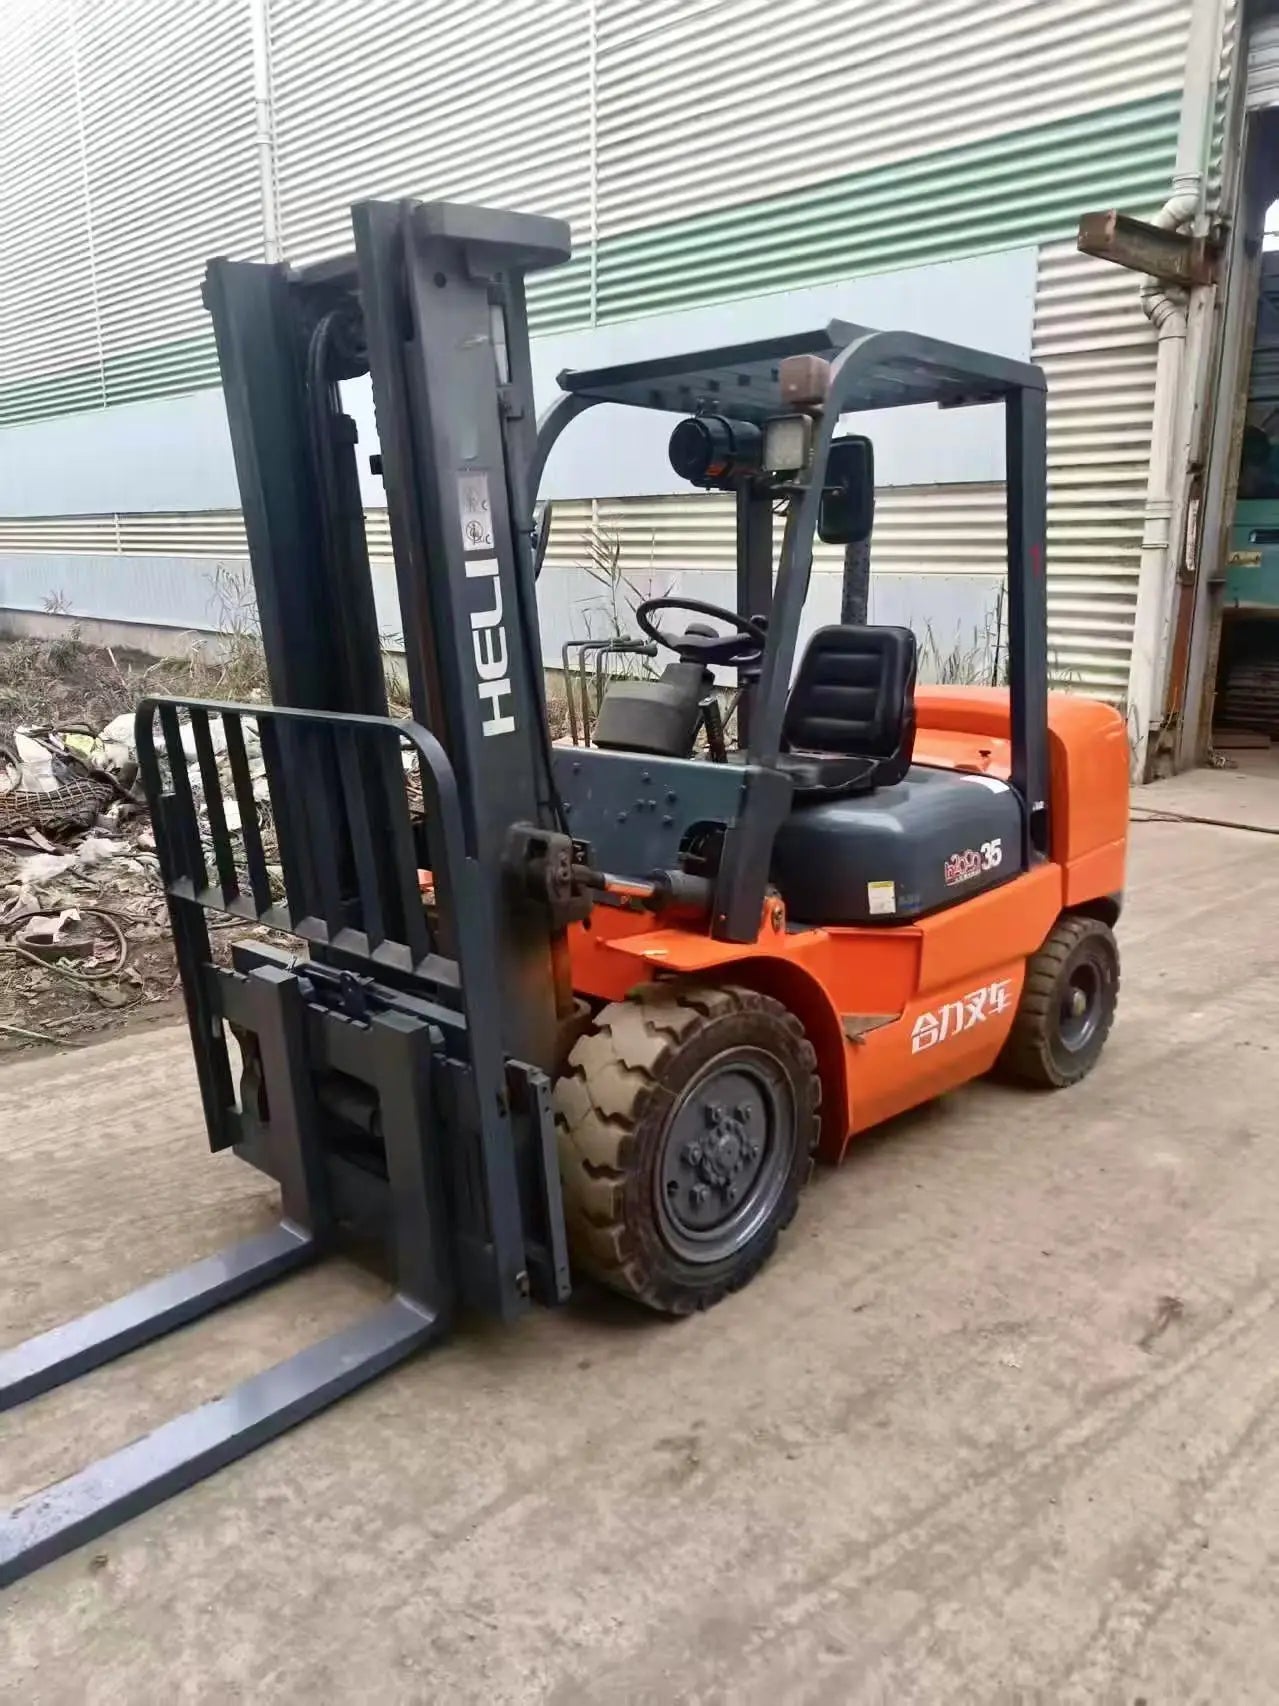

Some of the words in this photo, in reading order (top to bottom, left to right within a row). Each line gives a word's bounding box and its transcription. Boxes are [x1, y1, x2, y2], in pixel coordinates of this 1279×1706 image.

[464, 558, 516, 736] HELI
[980, 838, 1002, 870] 35
[911, 978, 1012, 1055] 合力叉车
